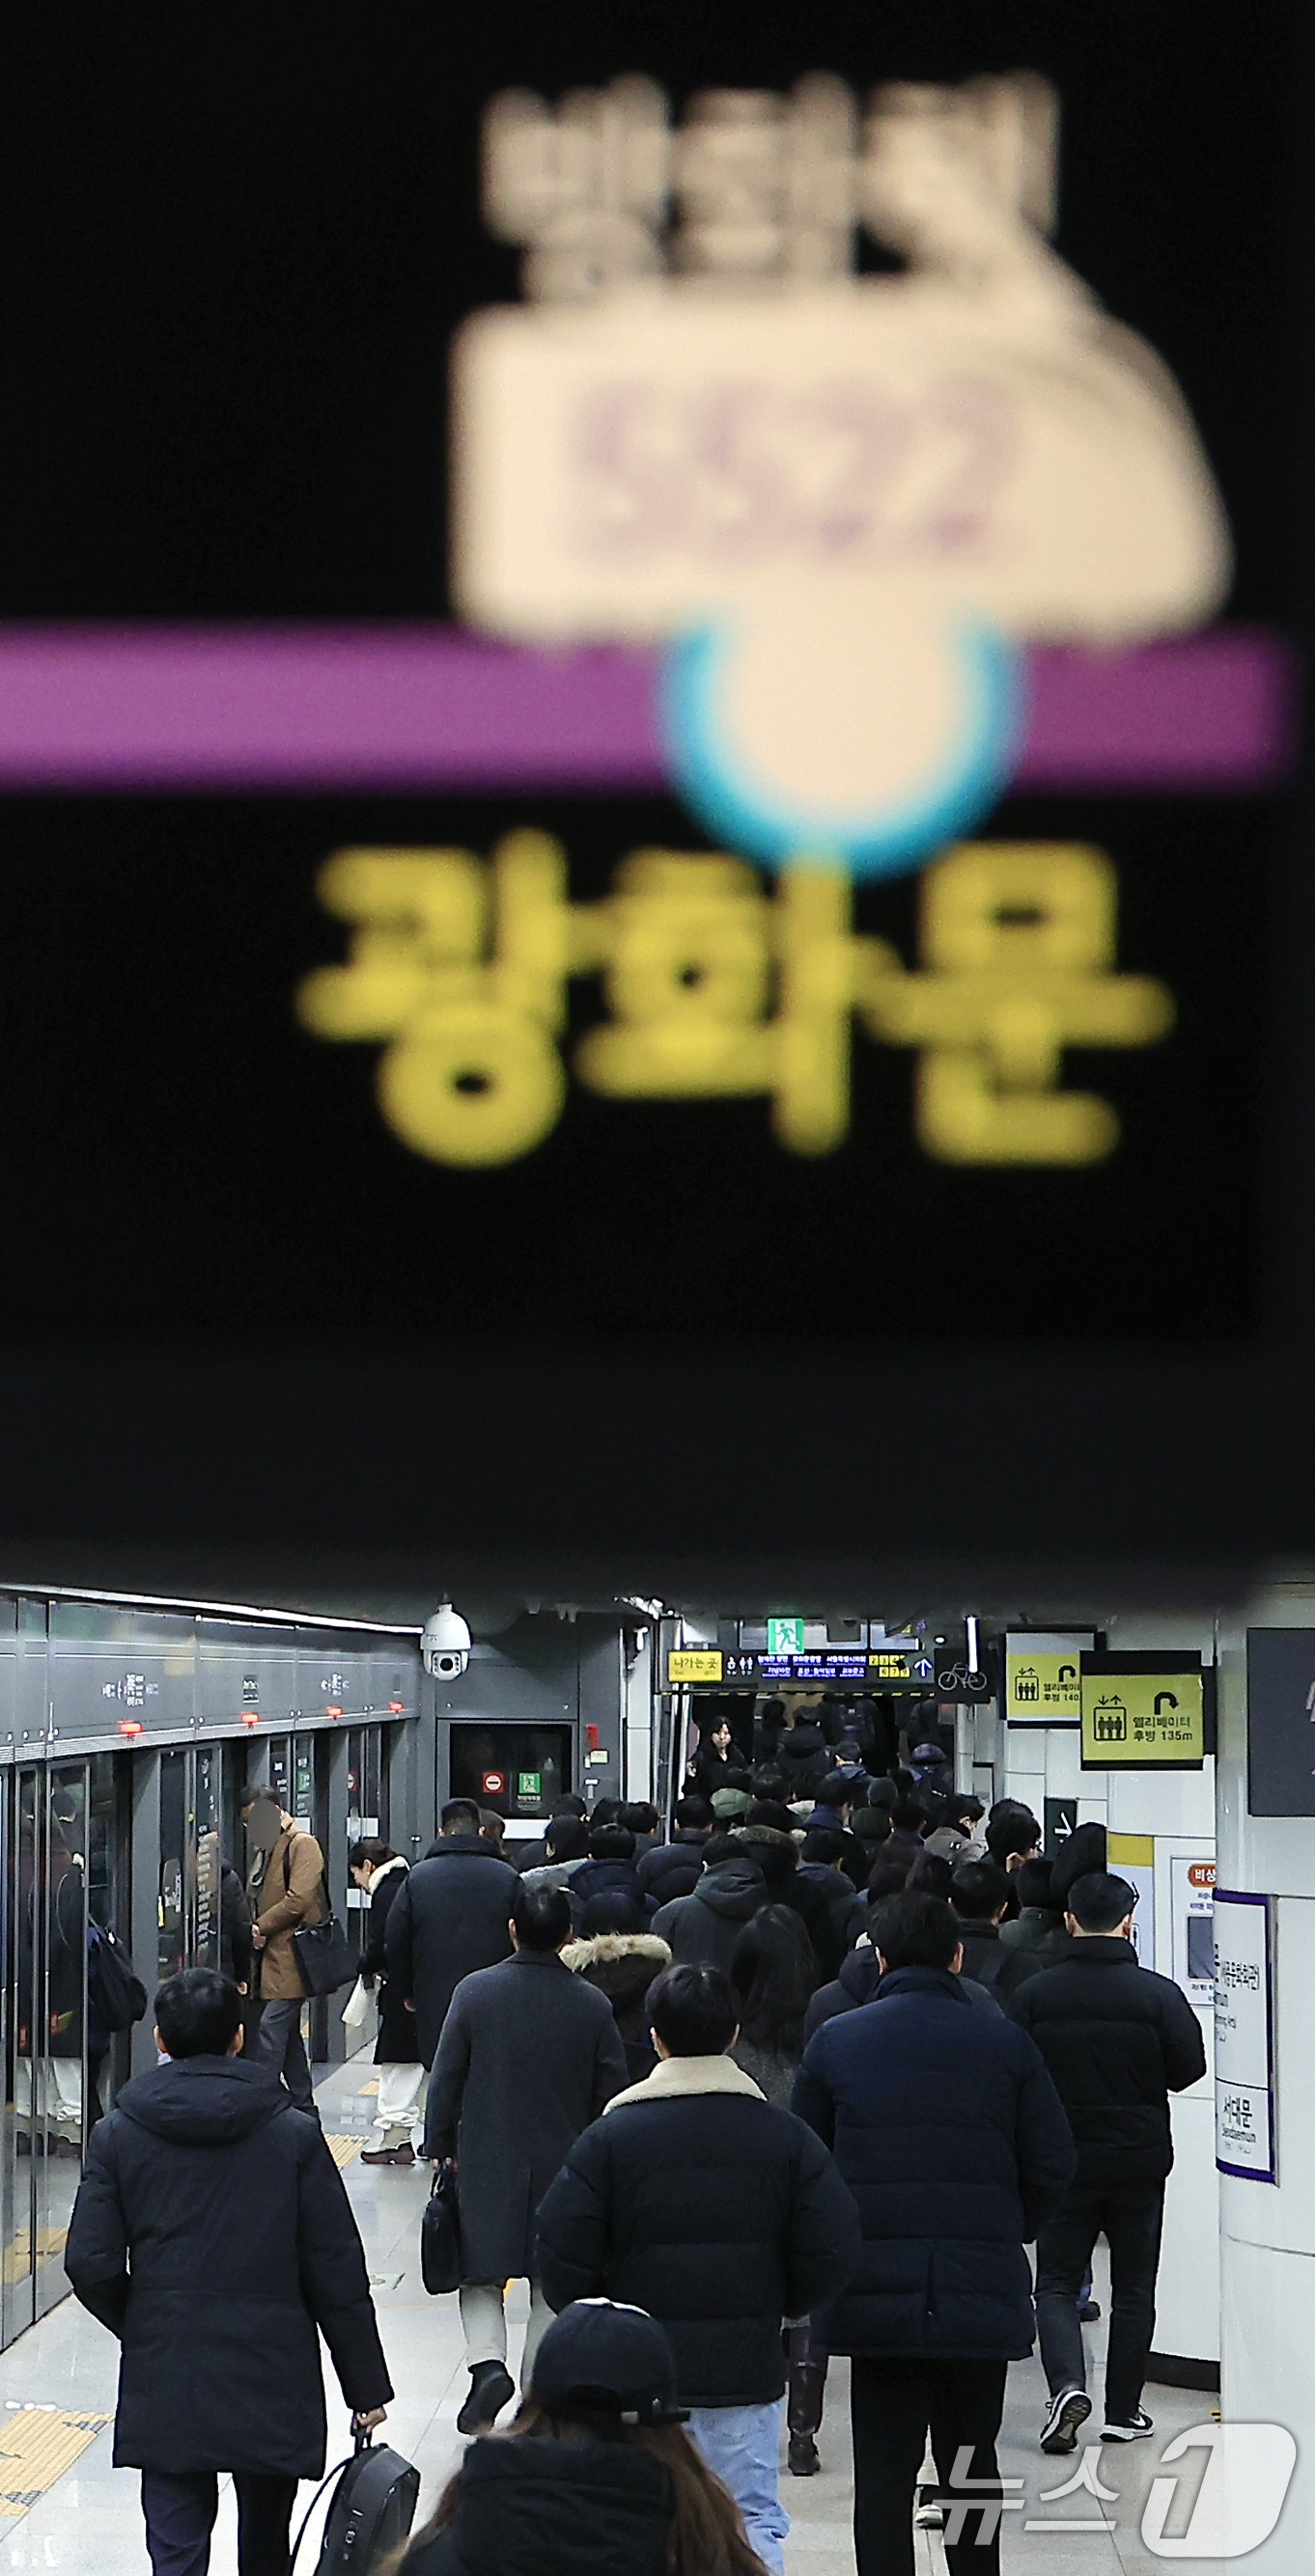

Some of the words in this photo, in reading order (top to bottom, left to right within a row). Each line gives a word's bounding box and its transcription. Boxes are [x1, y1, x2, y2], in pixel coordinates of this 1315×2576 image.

[295, 827, 1176, 1168] 광화문
[674, 1658, 704, 1669] 나가는
[707, 1658, 718, 1669] 곳
[1044, 1682, 1080, 1691] 엘리베이
[1133, 1717, 1190, 1728] 엘리베이터
[1133, 1731, 1156, 1741] 후방
[1161, 1731, 1193, 1741] 135m
[1222, 2094, 1253, 2129] 서대문
